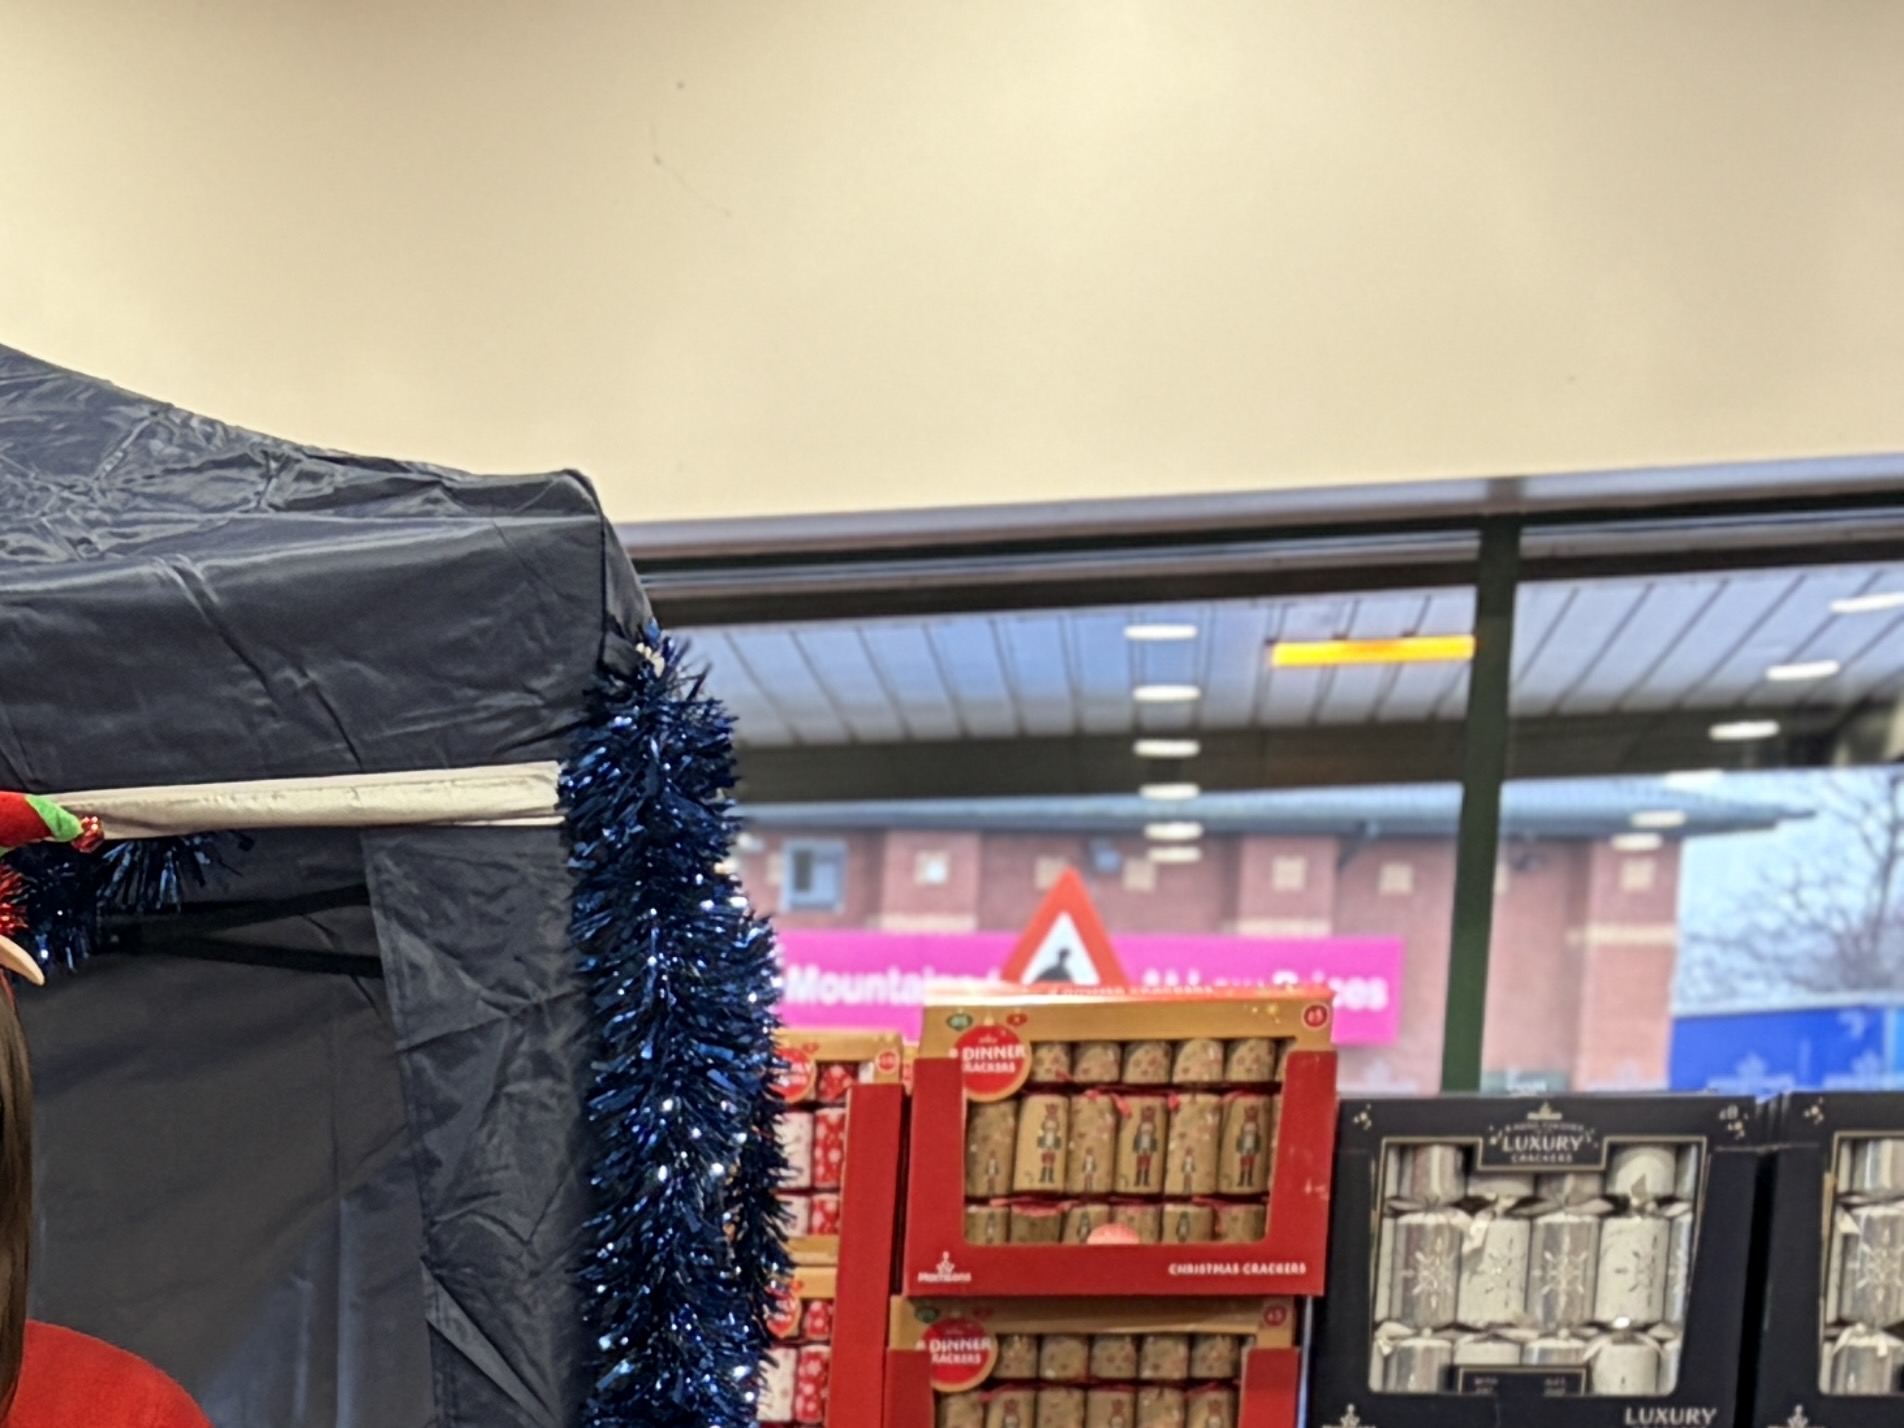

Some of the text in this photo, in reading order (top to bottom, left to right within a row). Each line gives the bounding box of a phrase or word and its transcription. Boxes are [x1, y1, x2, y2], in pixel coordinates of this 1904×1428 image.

[1502, 1135, 1583, 1152] LUXURY
[1168, 1262, 1307, 1276] CHRISTMAS CRACKERS
[1624, 1407, 1716, 1426] LUXURY
